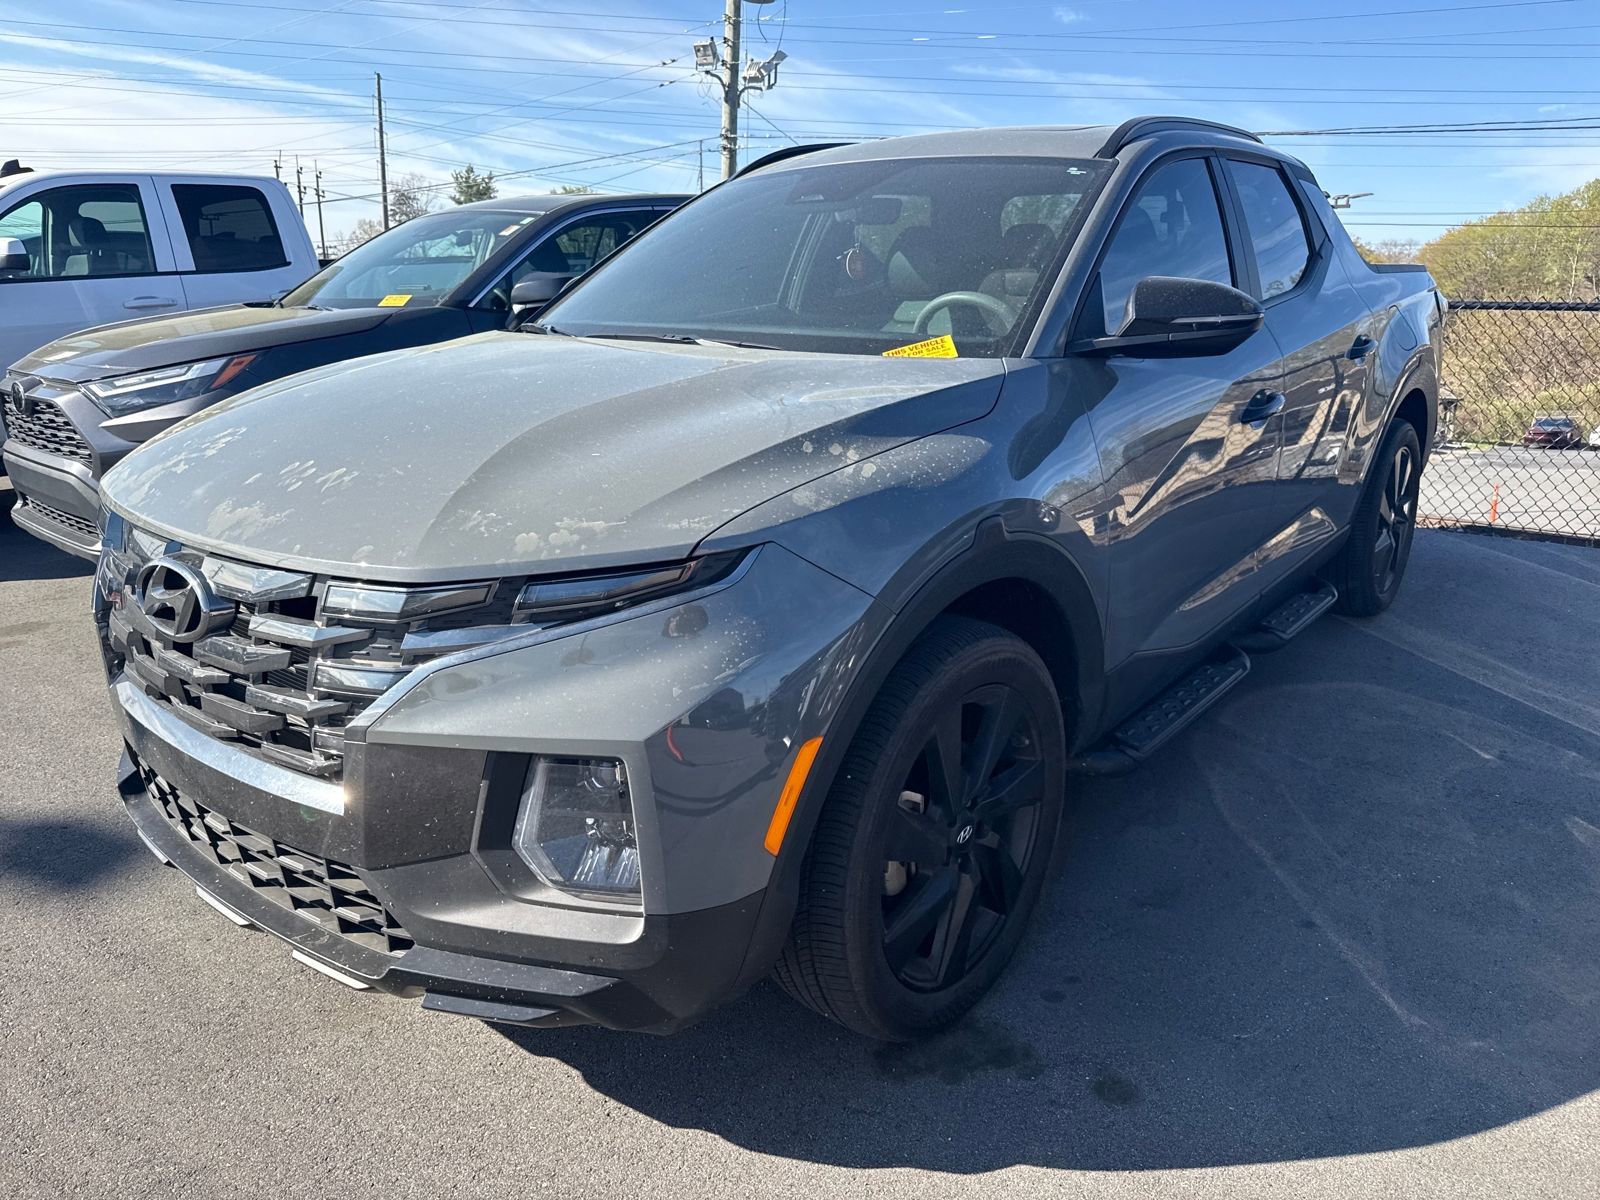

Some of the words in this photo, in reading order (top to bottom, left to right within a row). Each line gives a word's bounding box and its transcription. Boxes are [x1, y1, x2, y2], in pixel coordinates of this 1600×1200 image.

[886, 348, 907, 357] THIS
[908, 338, 946, 352] VEHICLE
[925, 344, 946, 352] SALE
